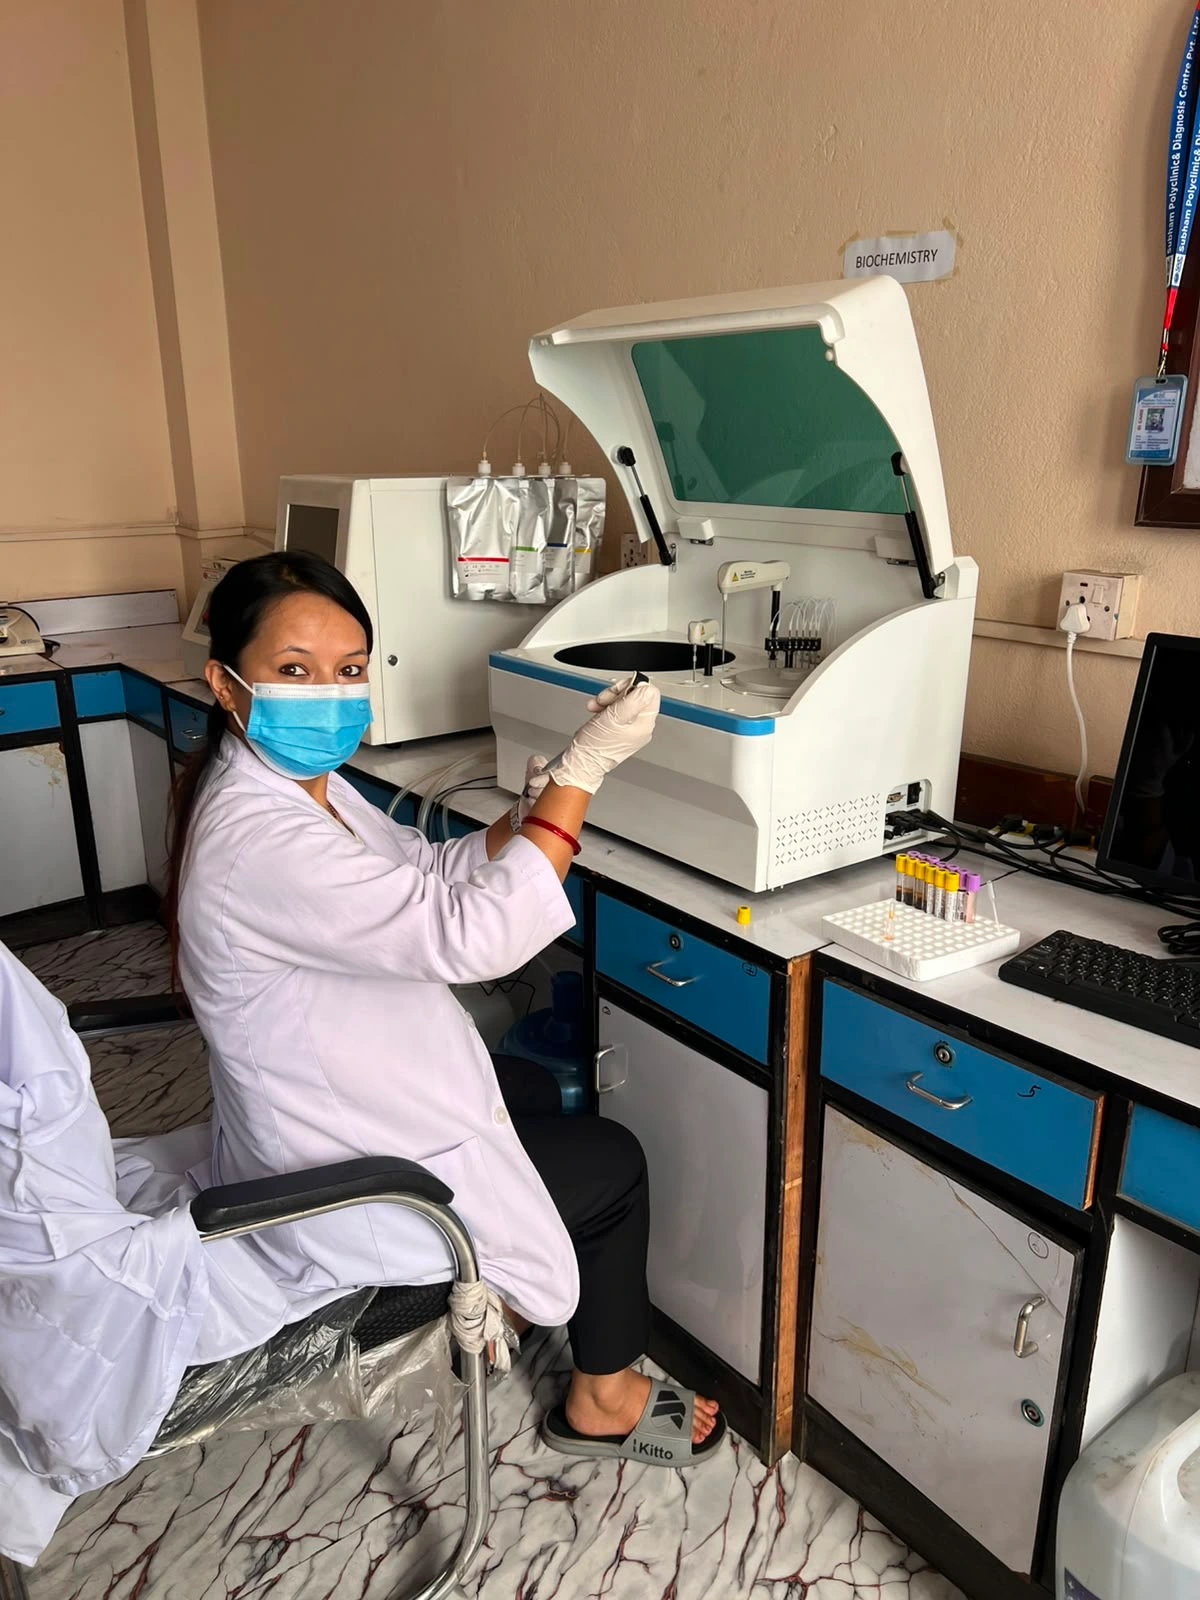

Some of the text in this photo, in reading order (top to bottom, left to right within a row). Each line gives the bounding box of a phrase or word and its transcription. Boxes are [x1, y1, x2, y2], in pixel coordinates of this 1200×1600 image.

[1172, 100, 1186, 150] Diagnosis
[1179, 62, 1192, 98] Centre
[1178, 209, 1191, 252] Subham
[855, 248, 938, 269] BIOCHEMISTRY
[639, 1441, 673, 1460] Kitto
